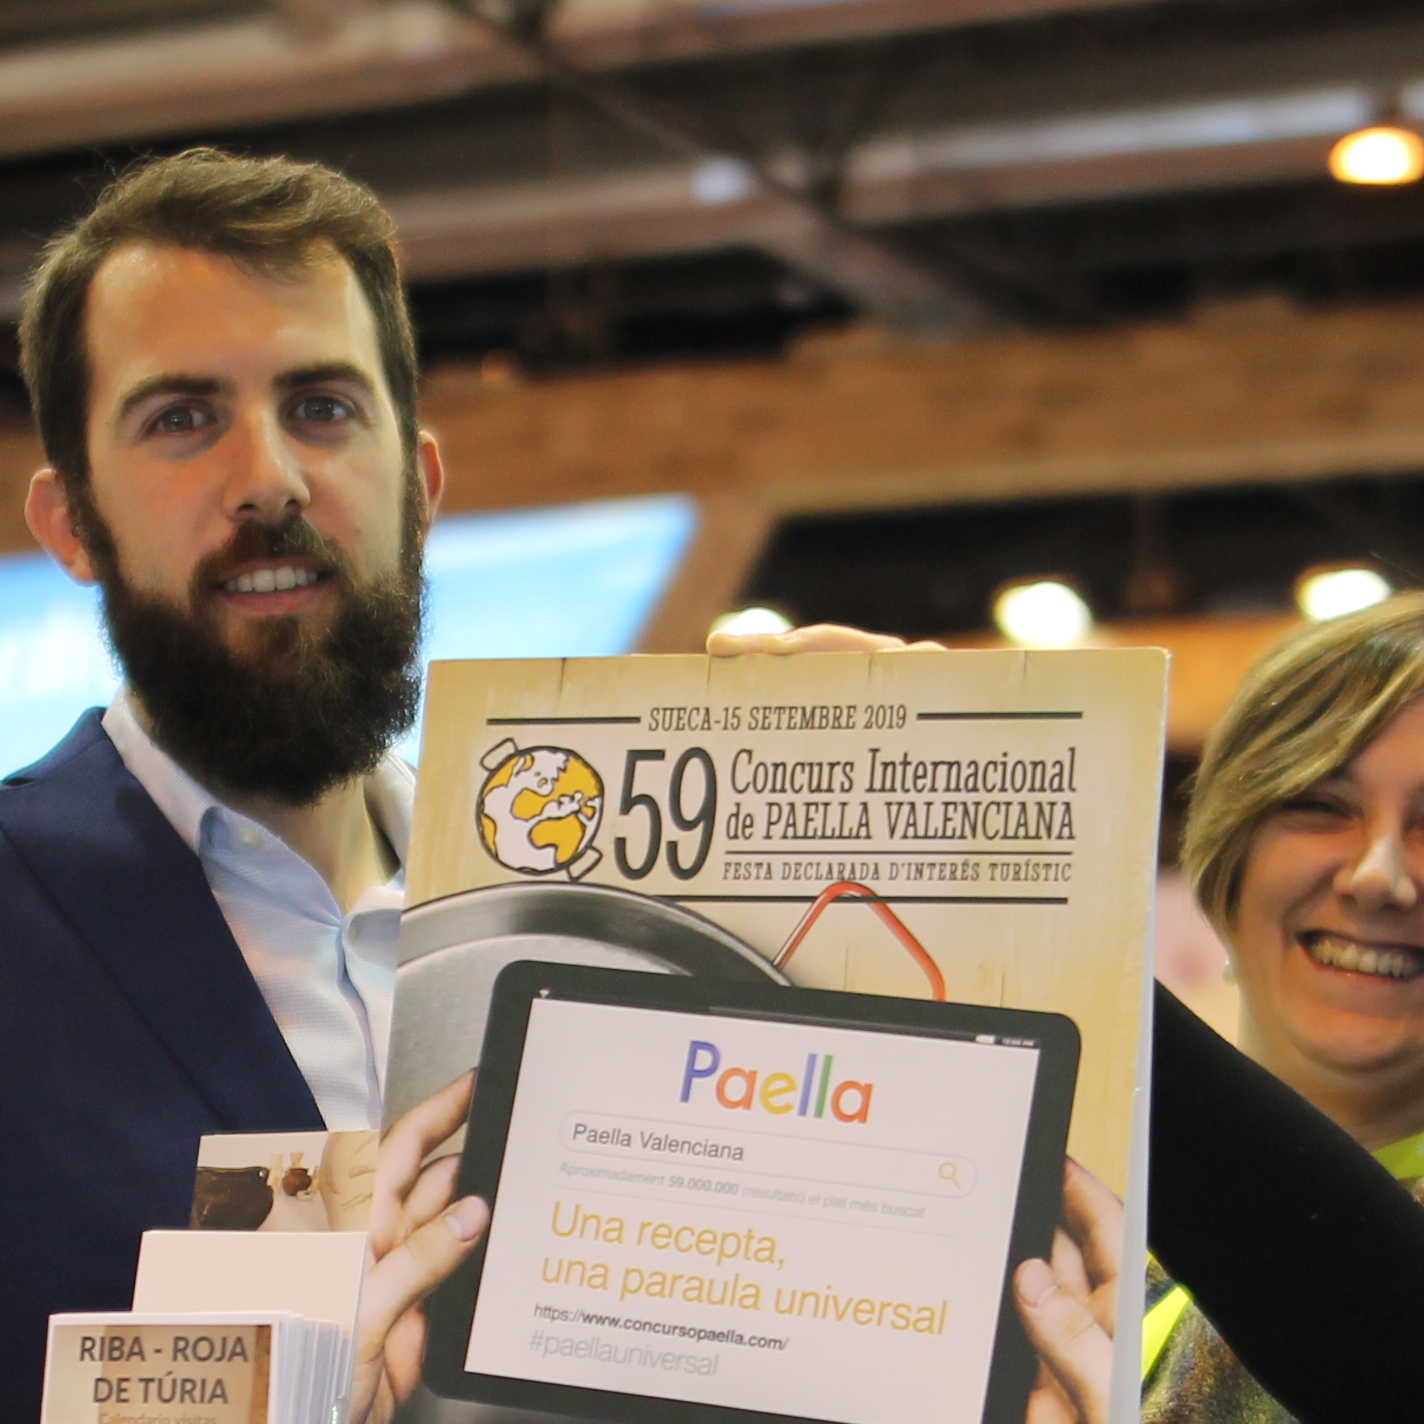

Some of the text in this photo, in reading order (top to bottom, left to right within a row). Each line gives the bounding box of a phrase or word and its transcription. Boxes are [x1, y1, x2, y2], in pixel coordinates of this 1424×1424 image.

[748, 706, 857, 730] SETEMBRE
[864, 704, 908, 729] 2019
[730, 746, 1078, 795] Concurs Internacional
[613, 746, 718, 882] 59
[726, 801, 1076, 842] de PAELLA VALENCIANA
[722, 862, 774, 881] FESTA
[780, 862, 881, 882] DECLARADA
[987, 860, 1073, 882] TURÍSTIC
[679, 1039, 874, 1125] Paella
[572, 1122, 745, 1163] Paella Valenciana
[550, 1202, 787, 1270] Una recepta,
[542, 1255, 950, 1337] una paraula universal
[79, 1336, 145, 1362] RIBA
[172, 1336, 249, 1363] ROJA
[529, 1329, 720, 1378] #paellauniversal
[93, 1371, 229, 1405] DE TÚRIA
